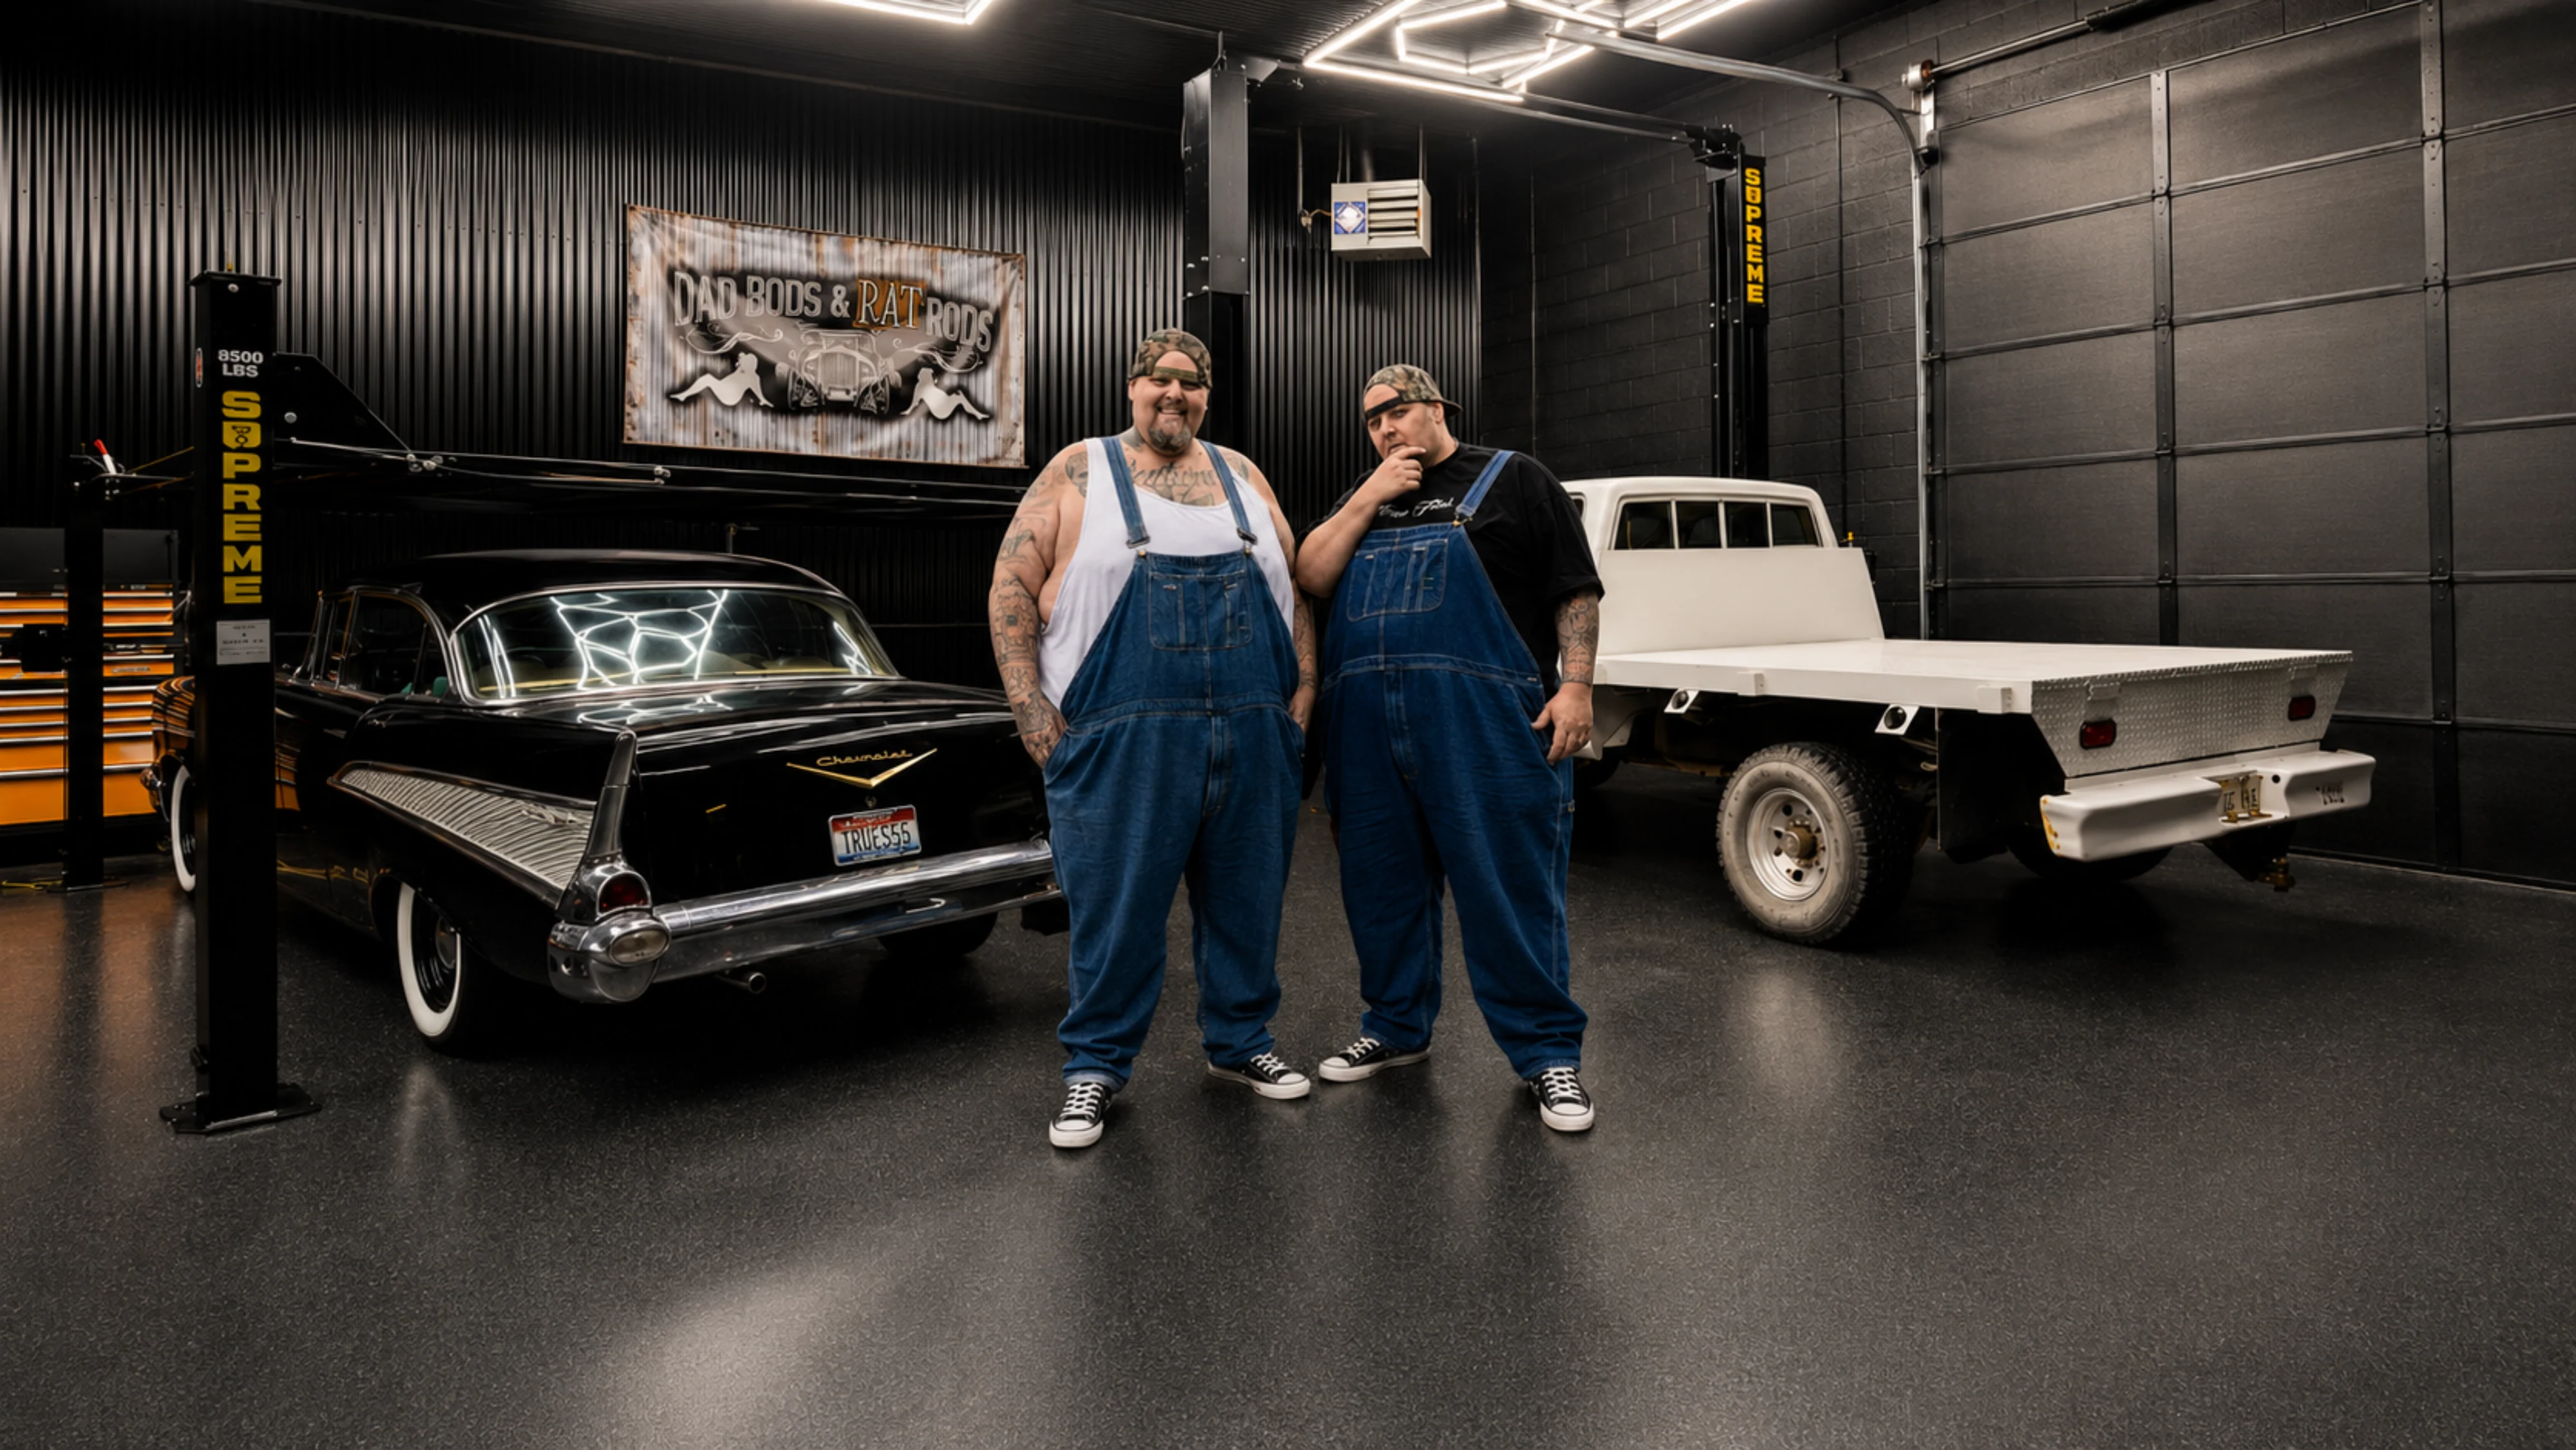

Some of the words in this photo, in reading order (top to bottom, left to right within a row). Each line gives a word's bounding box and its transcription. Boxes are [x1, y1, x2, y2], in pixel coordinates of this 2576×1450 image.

[674, 271, 737, 326] DAD
[745, 274, 822, 318] BODS
[830, 284, 851, 318] &
[858, 280, 923, 330] RAT
[925, 296, 993, 352] RODS
[218, 349, 264, 365] 8500
[222, 363, 259, 378] LBS
